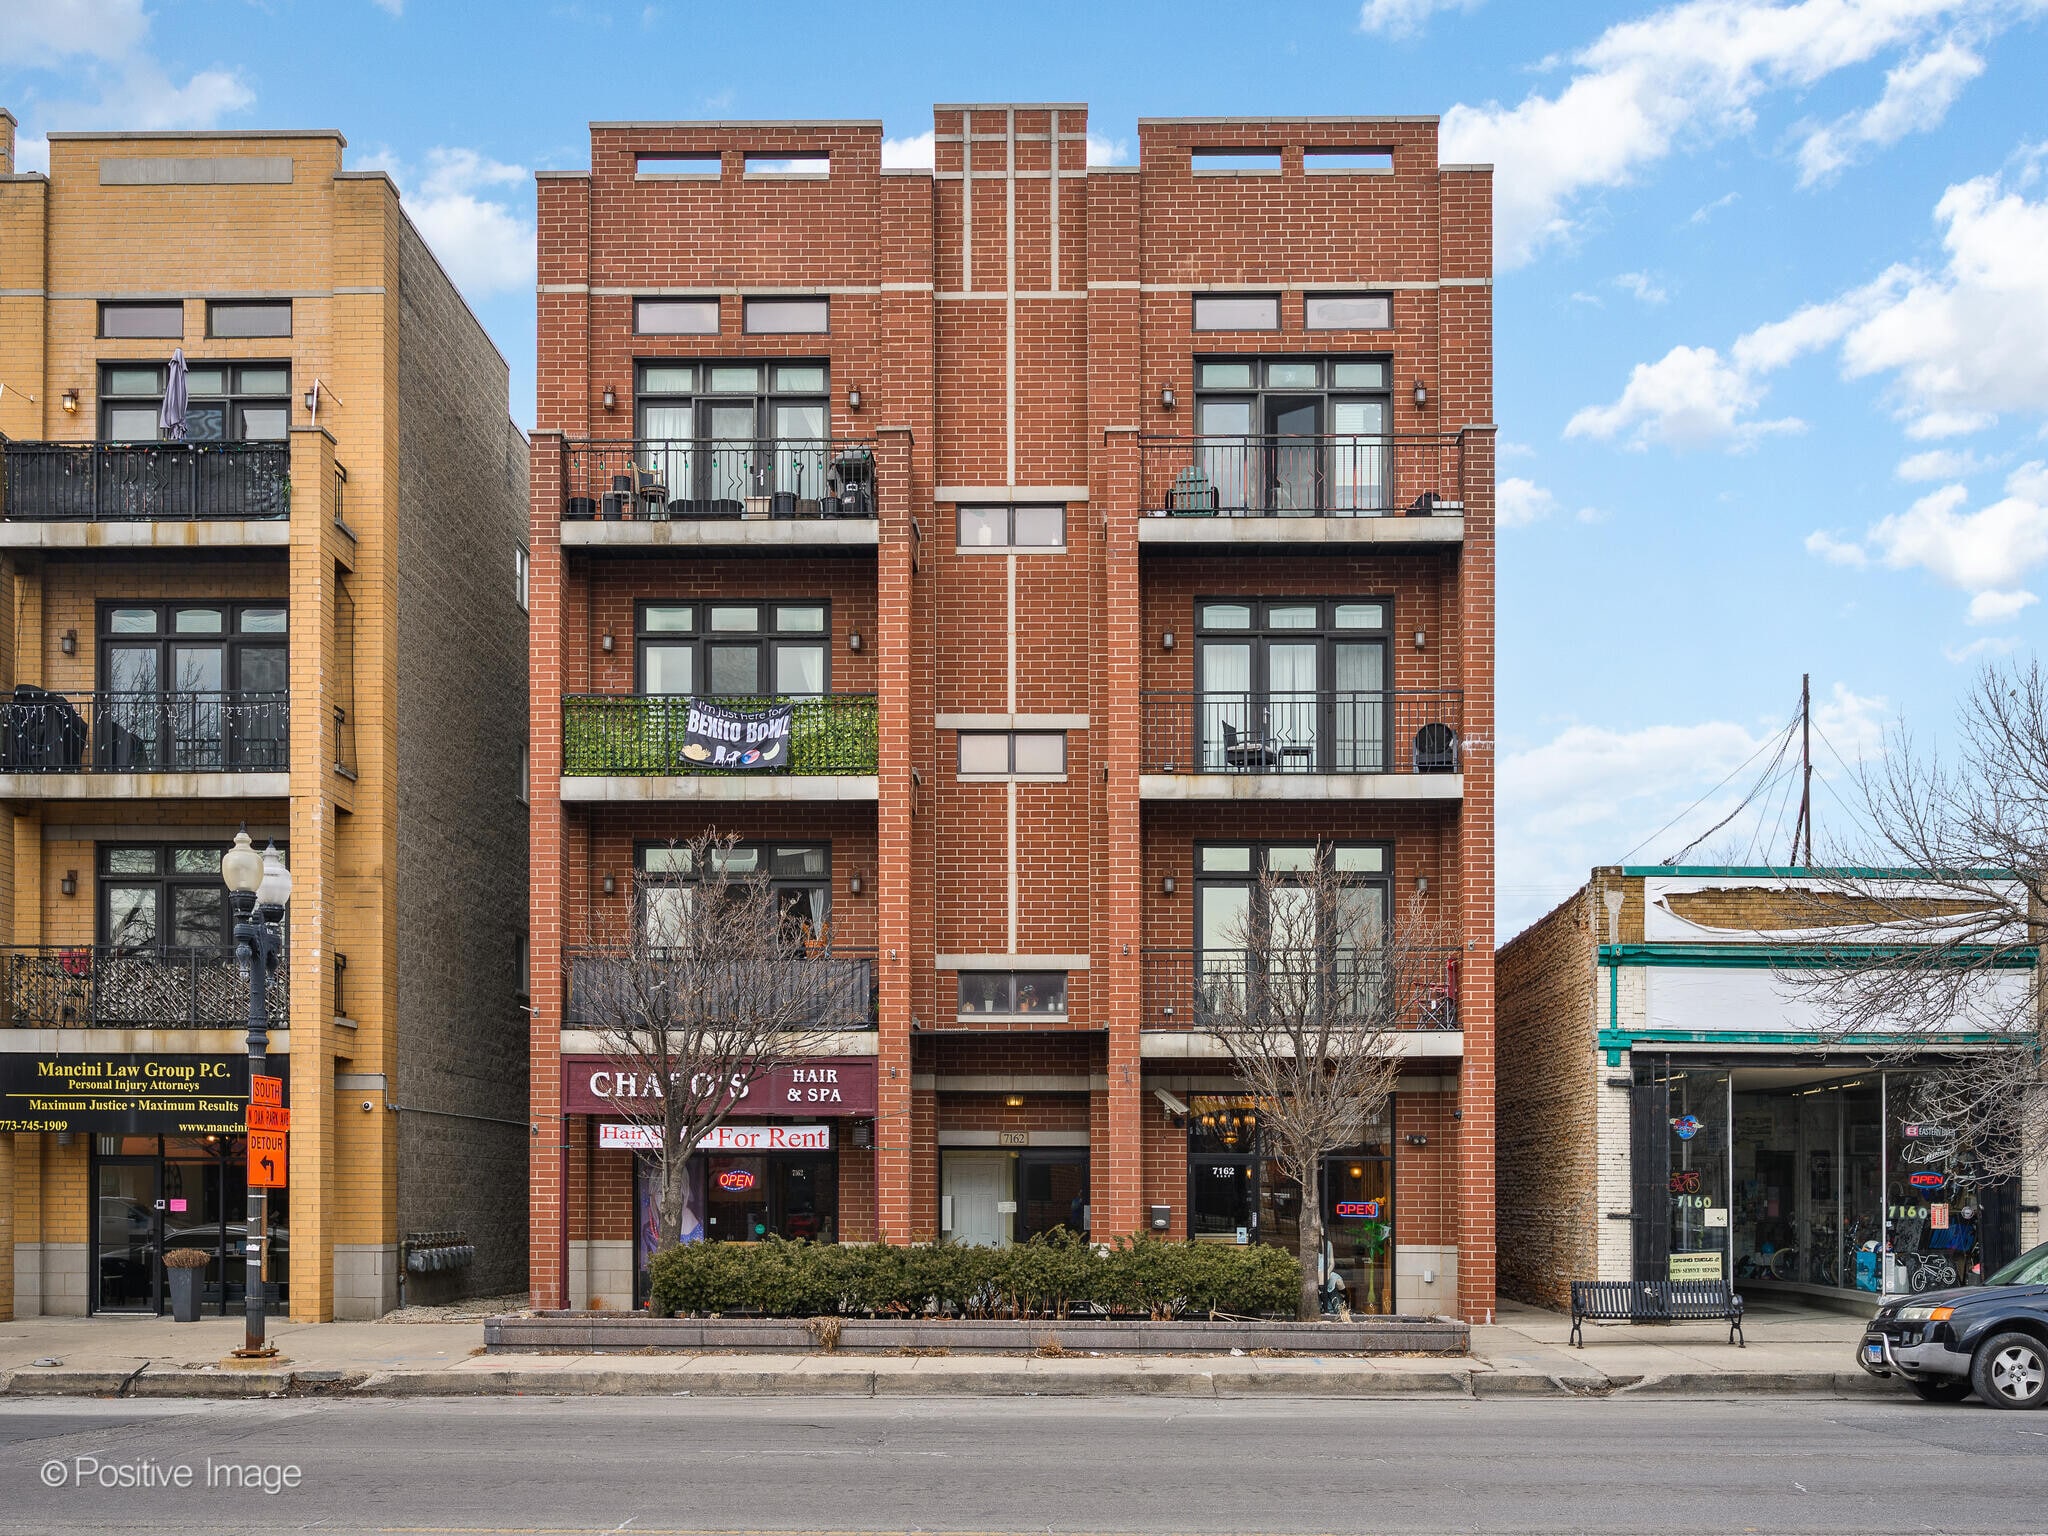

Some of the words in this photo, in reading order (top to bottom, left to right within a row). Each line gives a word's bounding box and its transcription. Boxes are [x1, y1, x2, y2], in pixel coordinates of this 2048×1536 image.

[699, 700, 715, 714] I'm
[716, 707, 738, 719] just
[740, 712, 765, 720] here
[768, 707, 782, 718] for
[38, 1062, 102, 1077] Mancini
[106, 1062, 140, 1077] Law
[144, 1062, 195, 1080] Group
[200, 1062, 231, 1078] P.C.
[793, 1069, 838, 1083] HAIR
[68, 1080, 112, 1090] Personal
[115, 1080, 148, 1092] Injury
[150, 1080, 200, 1092] Attorneys
[255, 1081, 281, 1099] SOUTH
[787, 1088, 802, 1102] &
[807, 1088, 842, 1102] SPA
[29, 1100, 87, 1111] Maximum
[89, 1099, 128, 1111] Justice
[138, 1100, 196, 1111] Maximum
[199, 1100, 239, 1112] Results
[254, 1110, 264, 1124] OAK
[266, 1110, 279, 1126] PARK
[280, 1112, 289, 1126] AVE
[0, 1120, 68, 1131] 773-745-1909
[251, 1135, 283, 1151] DETOUR
[603, 1126, 645, 1140] Hair
[717, 1127, 760, 1148] For
[768, 1127, 827, 1148] Rent
[1003, 1133, 1025, 1144] 7162
[1212, 1167, 1235, 1175] 7162
[719, 1173, 754, 1187] OPEN
[1910, 1175, 1944, 1185] OPEN
[1677, 1195, 1712, 1208] 7160
[1336, 1203, 1376, 1215] OPEN
[1889, 1205, 1928, 1219] 7160
